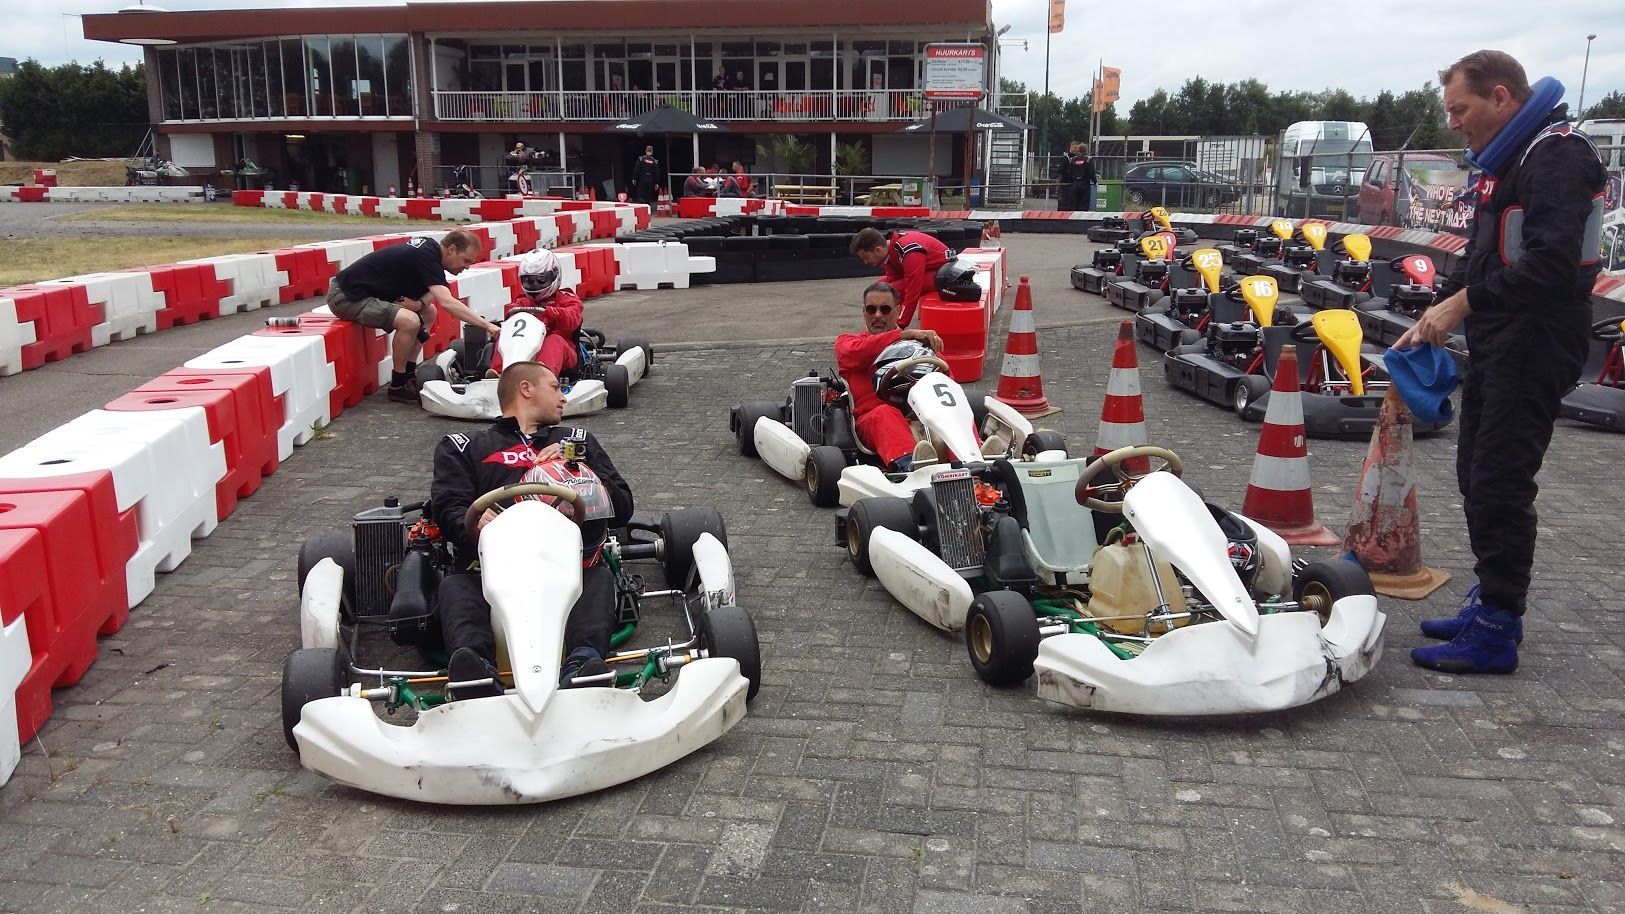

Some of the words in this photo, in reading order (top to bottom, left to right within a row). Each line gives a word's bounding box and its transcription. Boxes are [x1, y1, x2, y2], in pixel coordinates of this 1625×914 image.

[1426, 185, 1445, 201] WHO
[1445, 186, 1455, 201] IS
[1409, 206, 1425, 221] THE
[1424, 208, 1447, 226] NEXT
[1148, 239, 1164, 252] 21
[1198, 254, 1222, 267] 25
[1415, 259, 1428, 272] 9
[1252, 280, 1274, 297] 16
[511, 318, 527, 338] 2
[932, 383, 957, 407] 5
[936, 472, 969, 480] KOMBIKART
